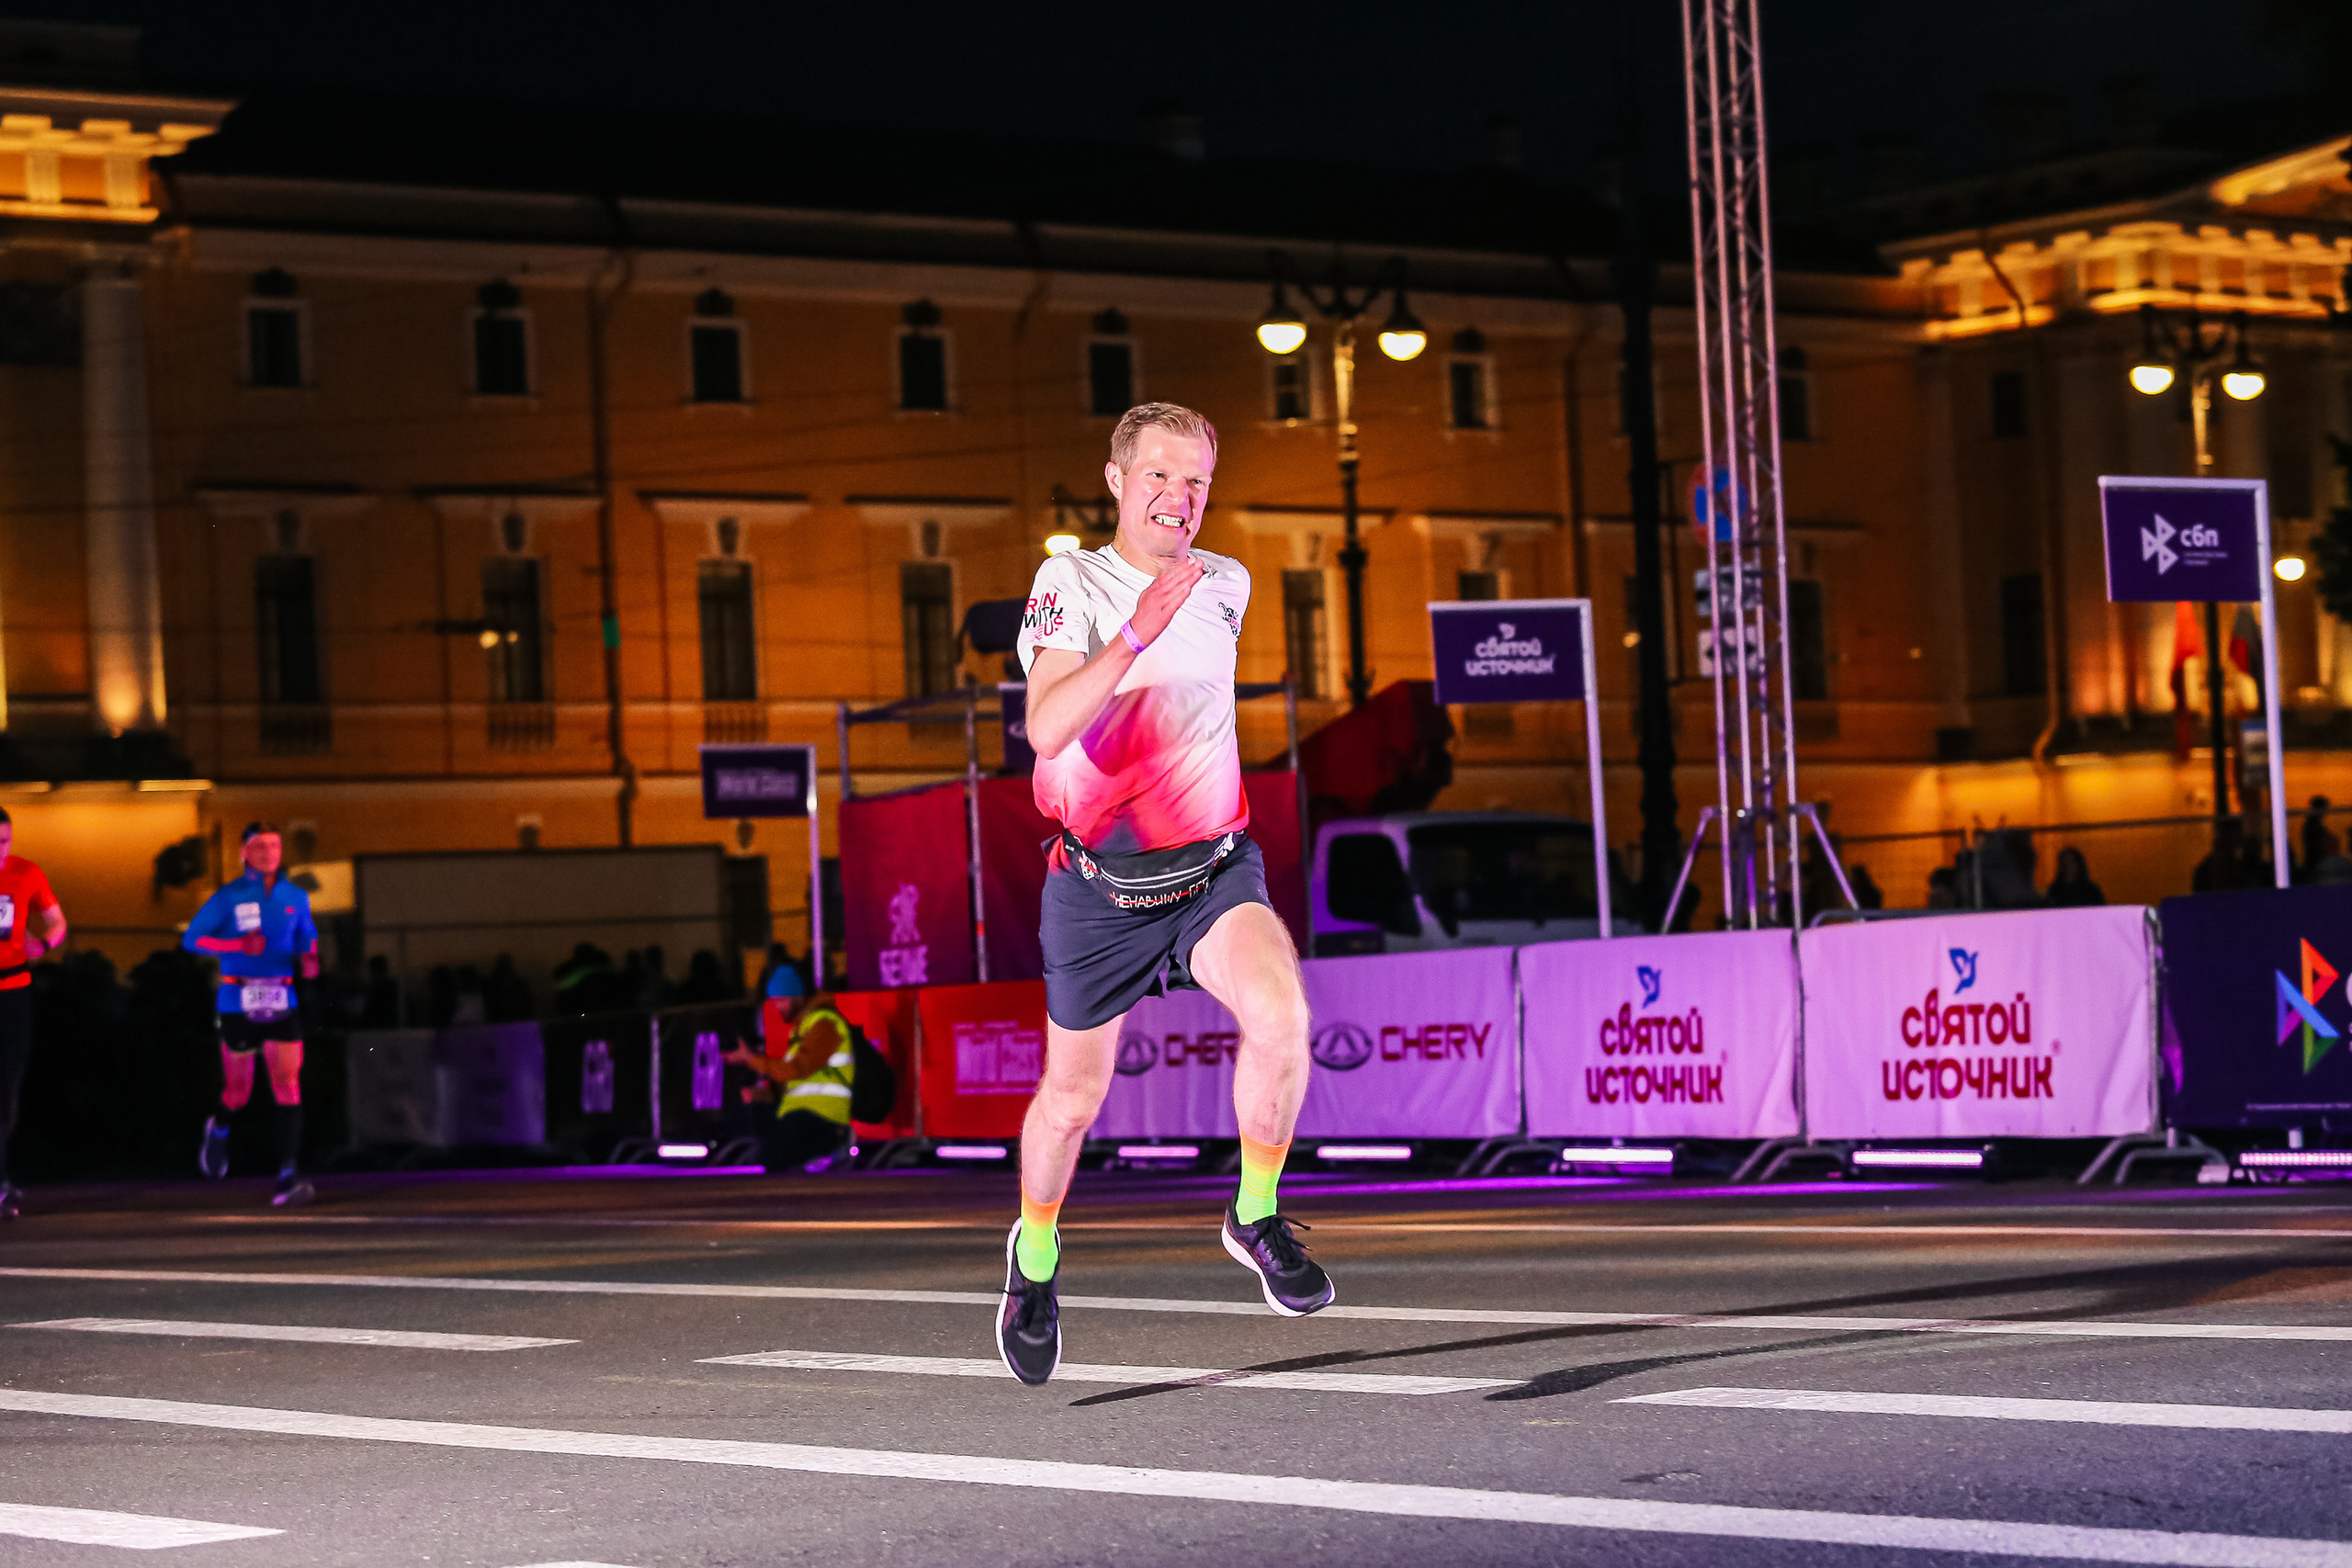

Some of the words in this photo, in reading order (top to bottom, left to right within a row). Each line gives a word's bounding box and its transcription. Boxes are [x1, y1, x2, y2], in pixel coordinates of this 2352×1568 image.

[1023, 606, 1063, 628] WITH
[1164, 1032, 1241, 1066] CHER
[1380, 1022, 1491, 1062] CHERY
